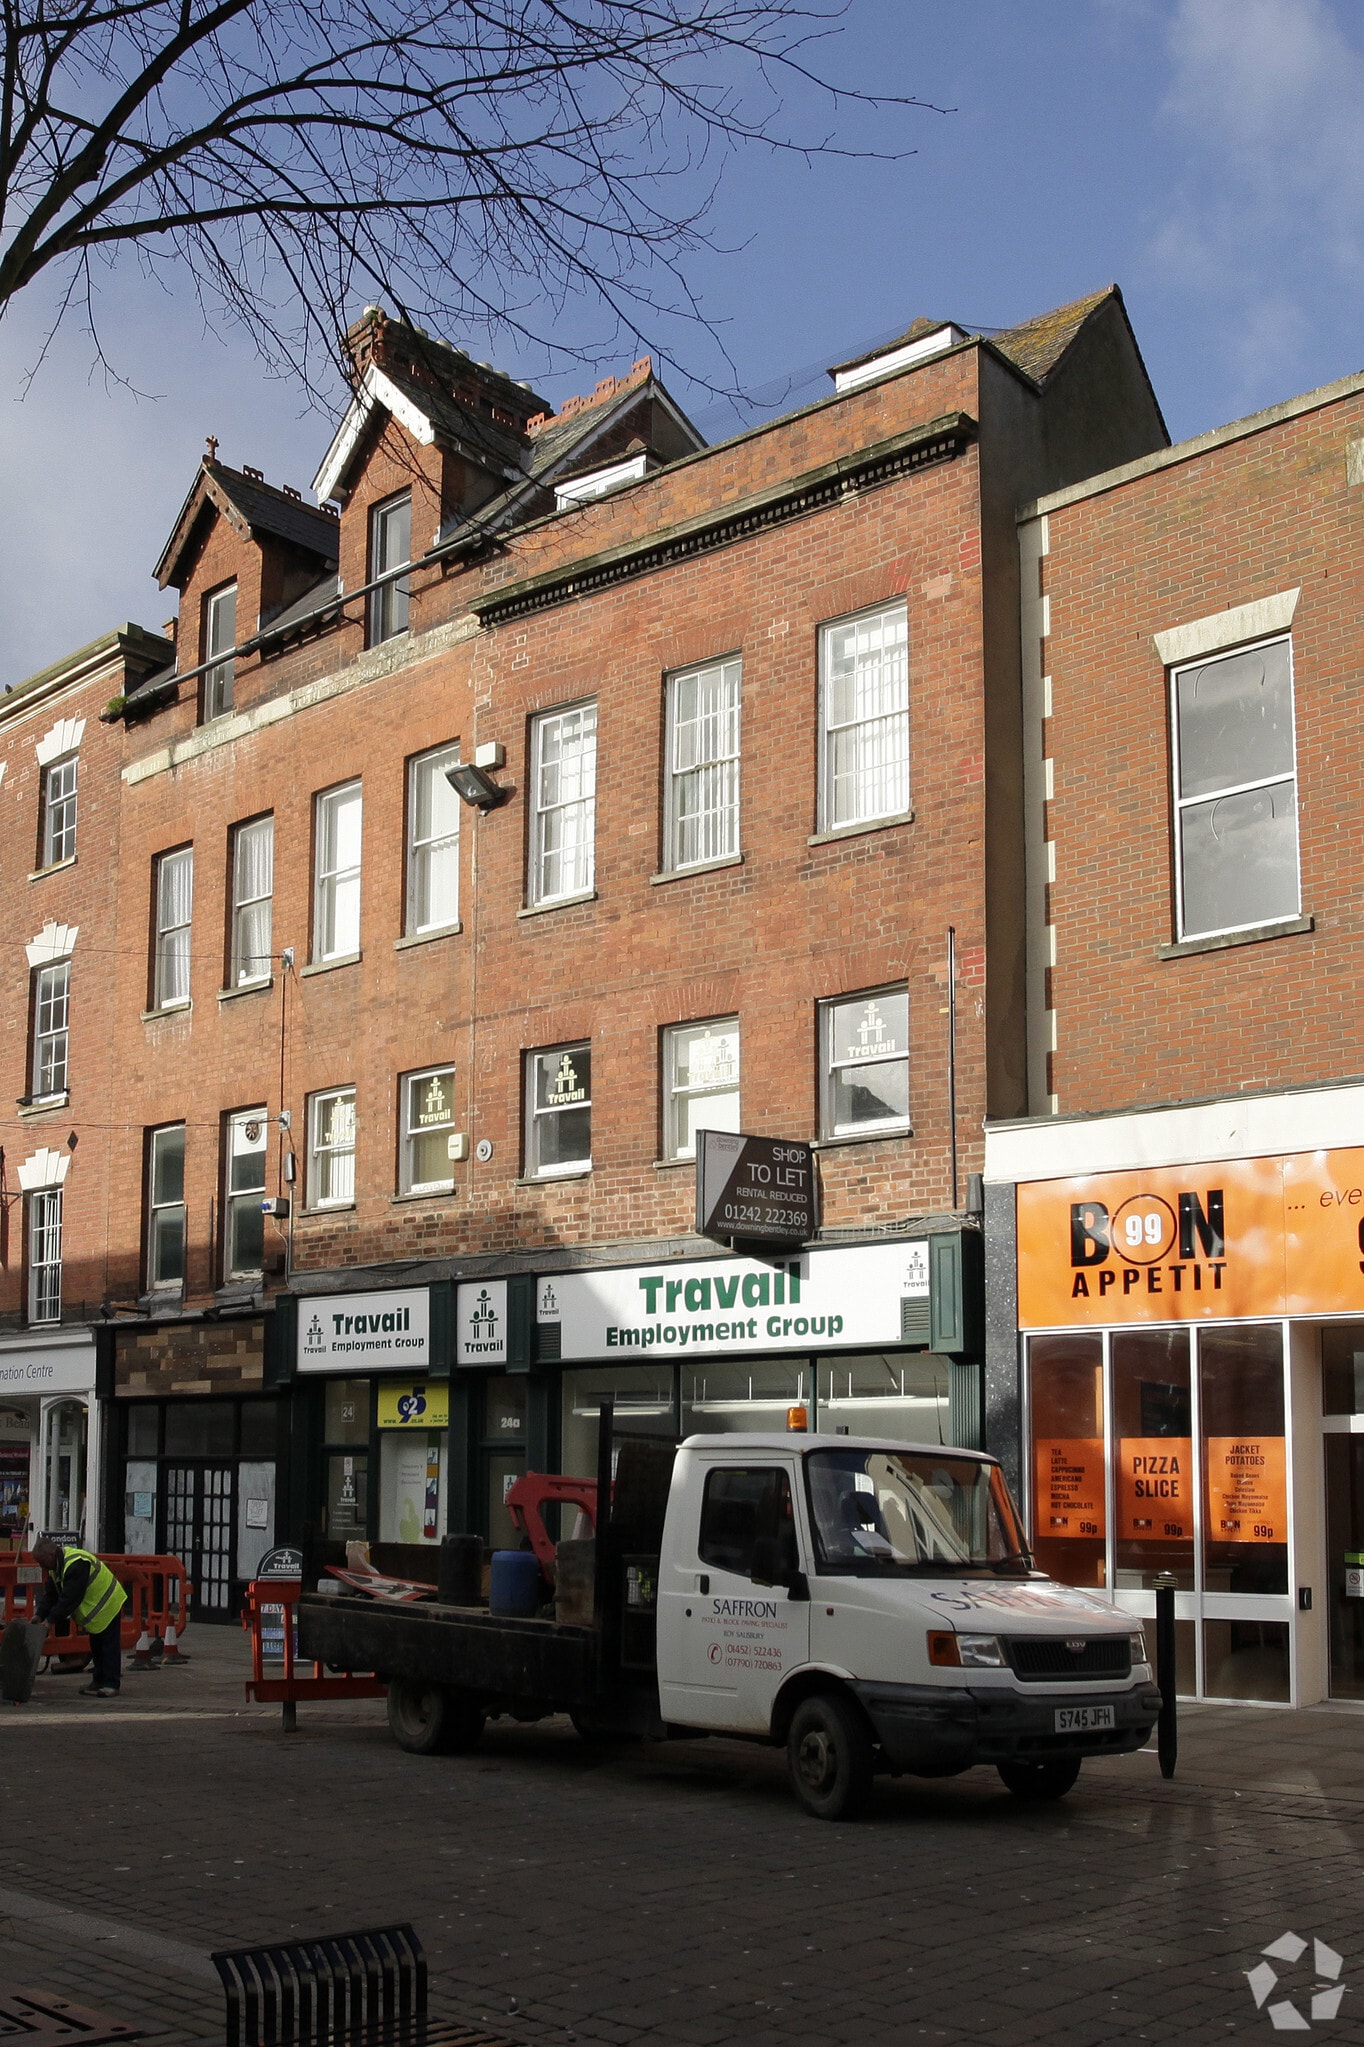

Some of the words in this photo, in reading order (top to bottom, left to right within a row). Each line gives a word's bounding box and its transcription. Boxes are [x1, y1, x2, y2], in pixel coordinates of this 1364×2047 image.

[848, 1039, 895, 1057] Travail
[548, 1087, 584, 1104] Travail
[419, 1109, 451, 1124] Travail
[772, 1147, 806, 1163] SHOP
[747, 1163, 771, 1183] TO
[776, 1166, 807, 1187] LET
[736, 1187, 768, 1199] RENTAL
[769, 1190, 807, 1203] REDUCED
[724, 1204, 761, 1222] 01242
[765, 1208, 808, 1227] 222369
[716, 1221, 808, 1236] www.downingbentley.co.uk
[1125, 1213, 1162, 1247] 99
[1071, 1262, 1227, 1298] APPETIT
[639, 1262, 801, 1314] Travail
[332, 1307, 410, 1335] Travail
[606, 1316, 757, 1348] Employment
[766, 1314, 844, 1338] Group
[303, 1346, 327, 1354] Travail
[331, 1339, 392, 1352] Employment
[395, 1337, 425, 1348] Group
[464, 1340, 503, 1353] Travail
[26, 1364, 54, 1379] Centre
[342, 1407, 353, 1417] 24
[501, 1417, 520, 1428] 24a
[1230, 1445, 1260, 1454] JACKET
[1133, 1457, 1180, 1474] PIZZA
[1225, 1456, 1265, 1465] POTATOES
[1135, 1480, 1179, 1498] SLICE
[1080, 1522, 1098, 1535] 99p
[1164, 1524, 1183, 1537] 99p
[1254, 1525, 1273, 1539] 99p
[713, 1599, 777, 1618] SAFFRON
[761, 1621, 788, 1629] SPECIALIST
[736, 1631, 765, 1640] SALISBURY
[725, 1643, 751, 1655] (01452)
[754, 1646, 782, 1657] 522436
[1066, 1640, 1086, 1648] LDV
[725, 1657, 753, 1669] (07790)
[754, 1659, 782, 1671] 720863
[1059, 1711, 1088, 1729] S745
[1090, 1709, 1111, 1726] JFH
